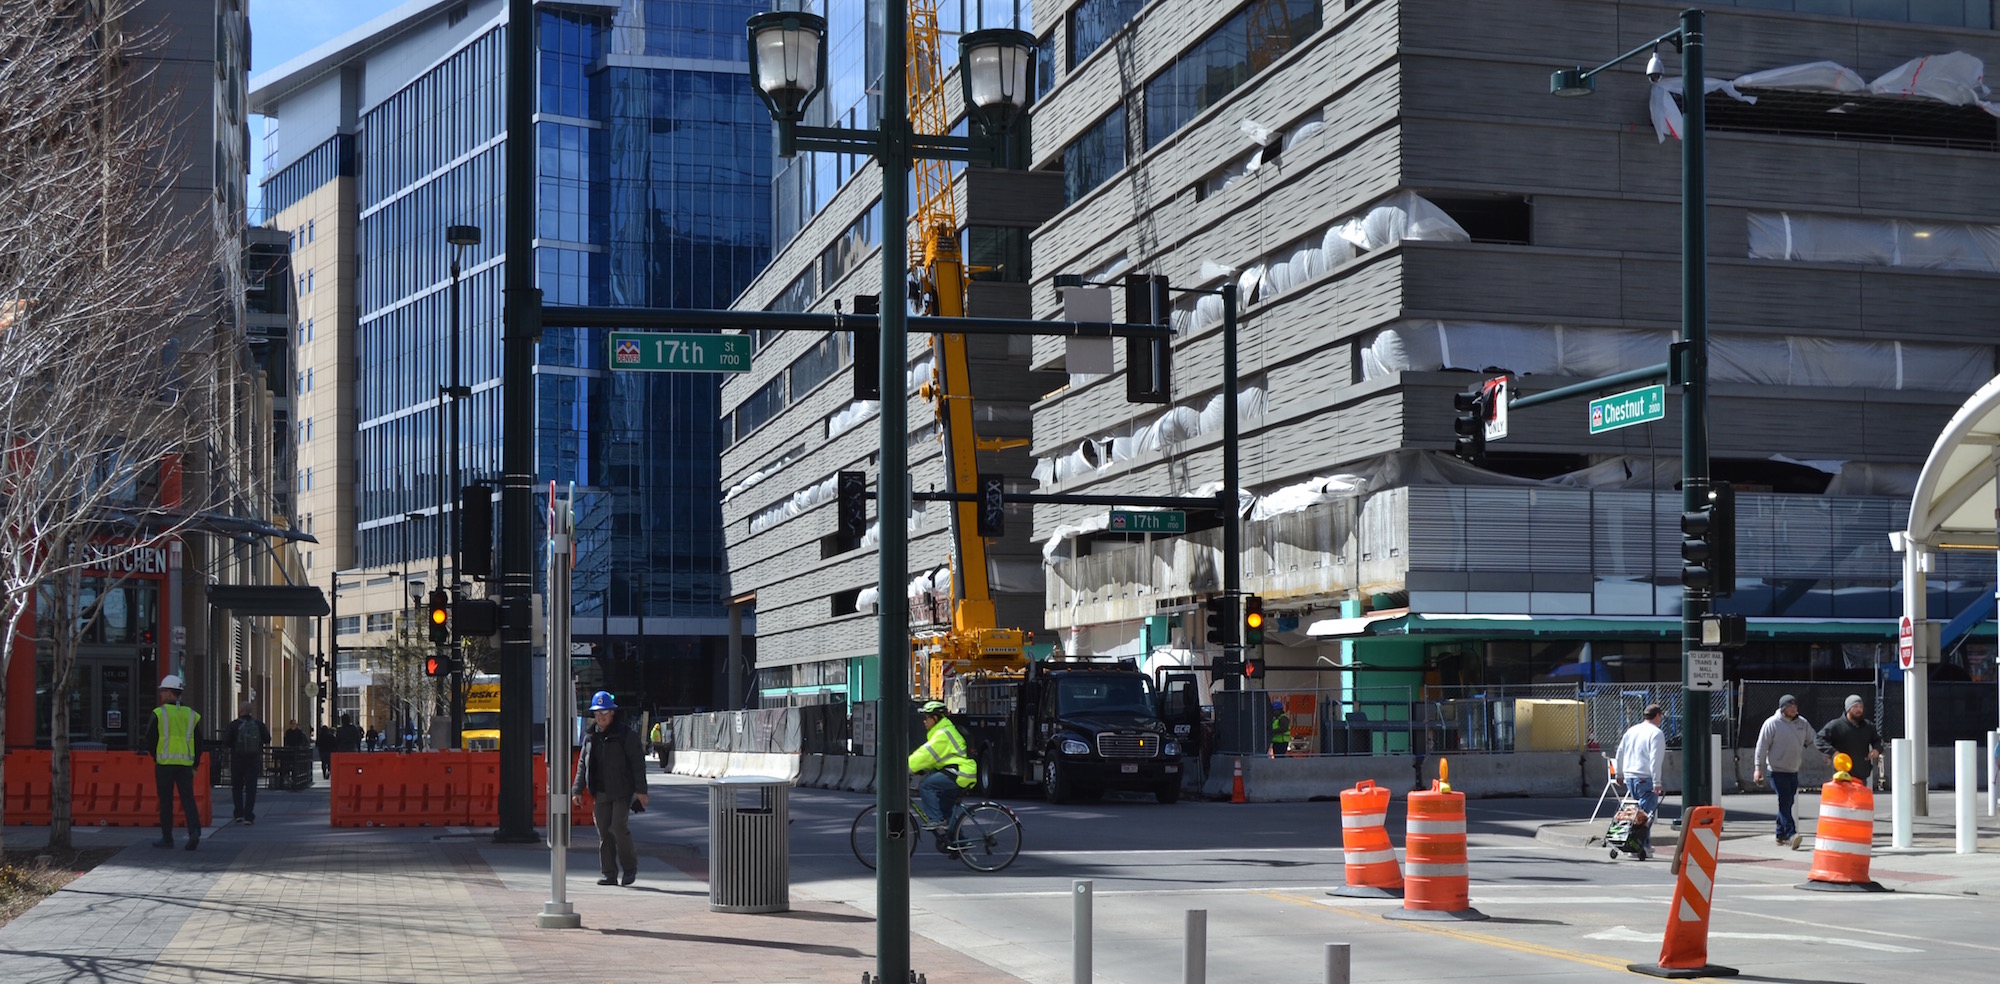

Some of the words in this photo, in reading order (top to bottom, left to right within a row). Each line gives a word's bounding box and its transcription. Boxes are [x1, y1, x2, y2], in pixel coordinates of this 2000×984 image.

[655, 340, 704, 364] 17th
[724, 341, 735, 352] St
[618, 354, 640, 363] DENVER
[720, 354, 740, 365] 1700
[1652, 392, 1657, 402] Pl
[1604, 396, 1645, 424] Chestnut
[1648, 403, 1661, 414] 2000
[1488, 420, 1504, 435] ONLY
[1133, 514, 1160, 529] 17th
[94, 544, 166, 573] KITCHEN
[1174, 725, 1191, 733] GCR
